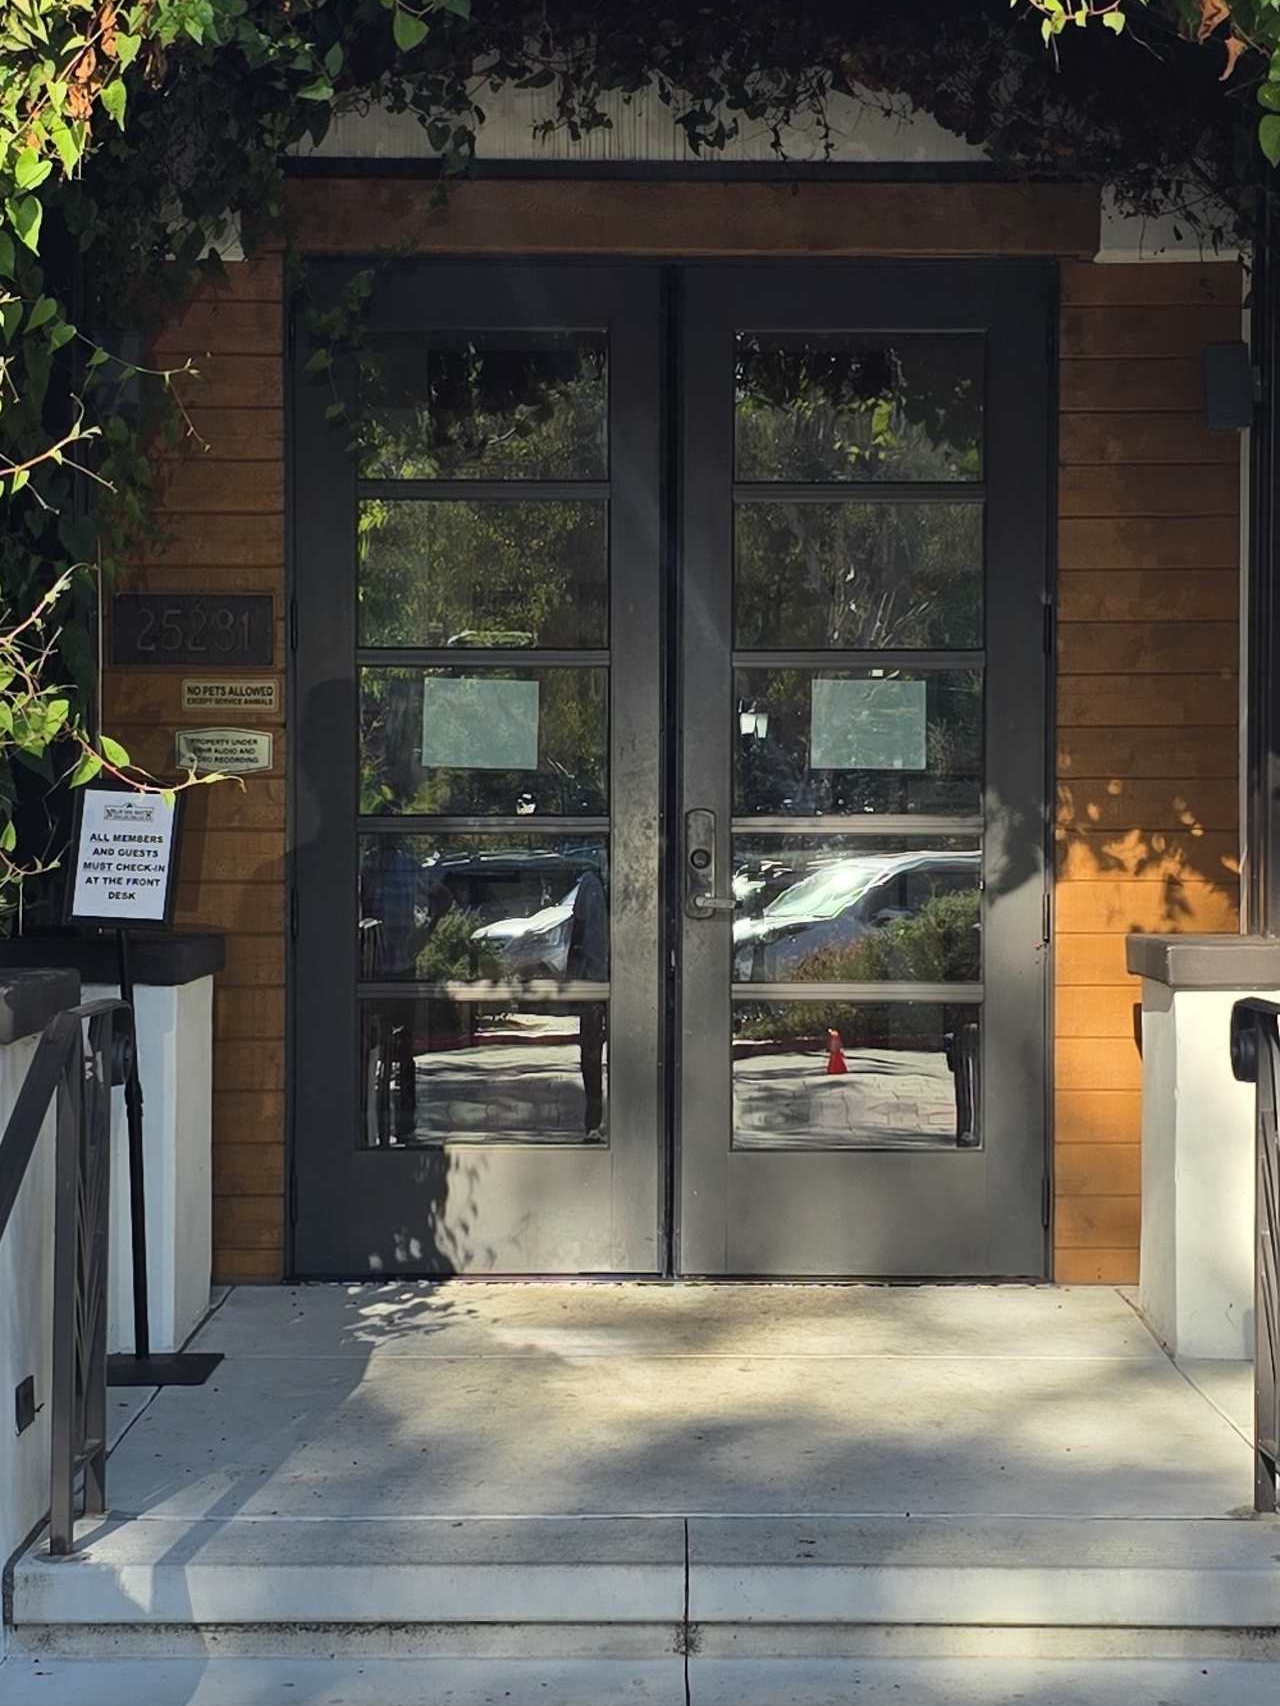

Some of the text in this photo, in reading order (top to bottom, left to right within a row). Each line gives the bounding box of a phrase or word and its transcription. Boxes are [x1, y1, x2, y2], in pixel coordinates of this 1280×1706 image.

[136, 608, 250, 652] 25281
[186, 685, 274, 697] NO PETS ALLOWED
[90, 833, 164, 844] ALL MEMBERS
[92, 848, 159, 858] AND GUESTS
[83, 862, 166, 873] MUST CHECK-IN
[85, 877, 160, 887] AT THE FRONT
[108, 892, 136, 900] DESK
